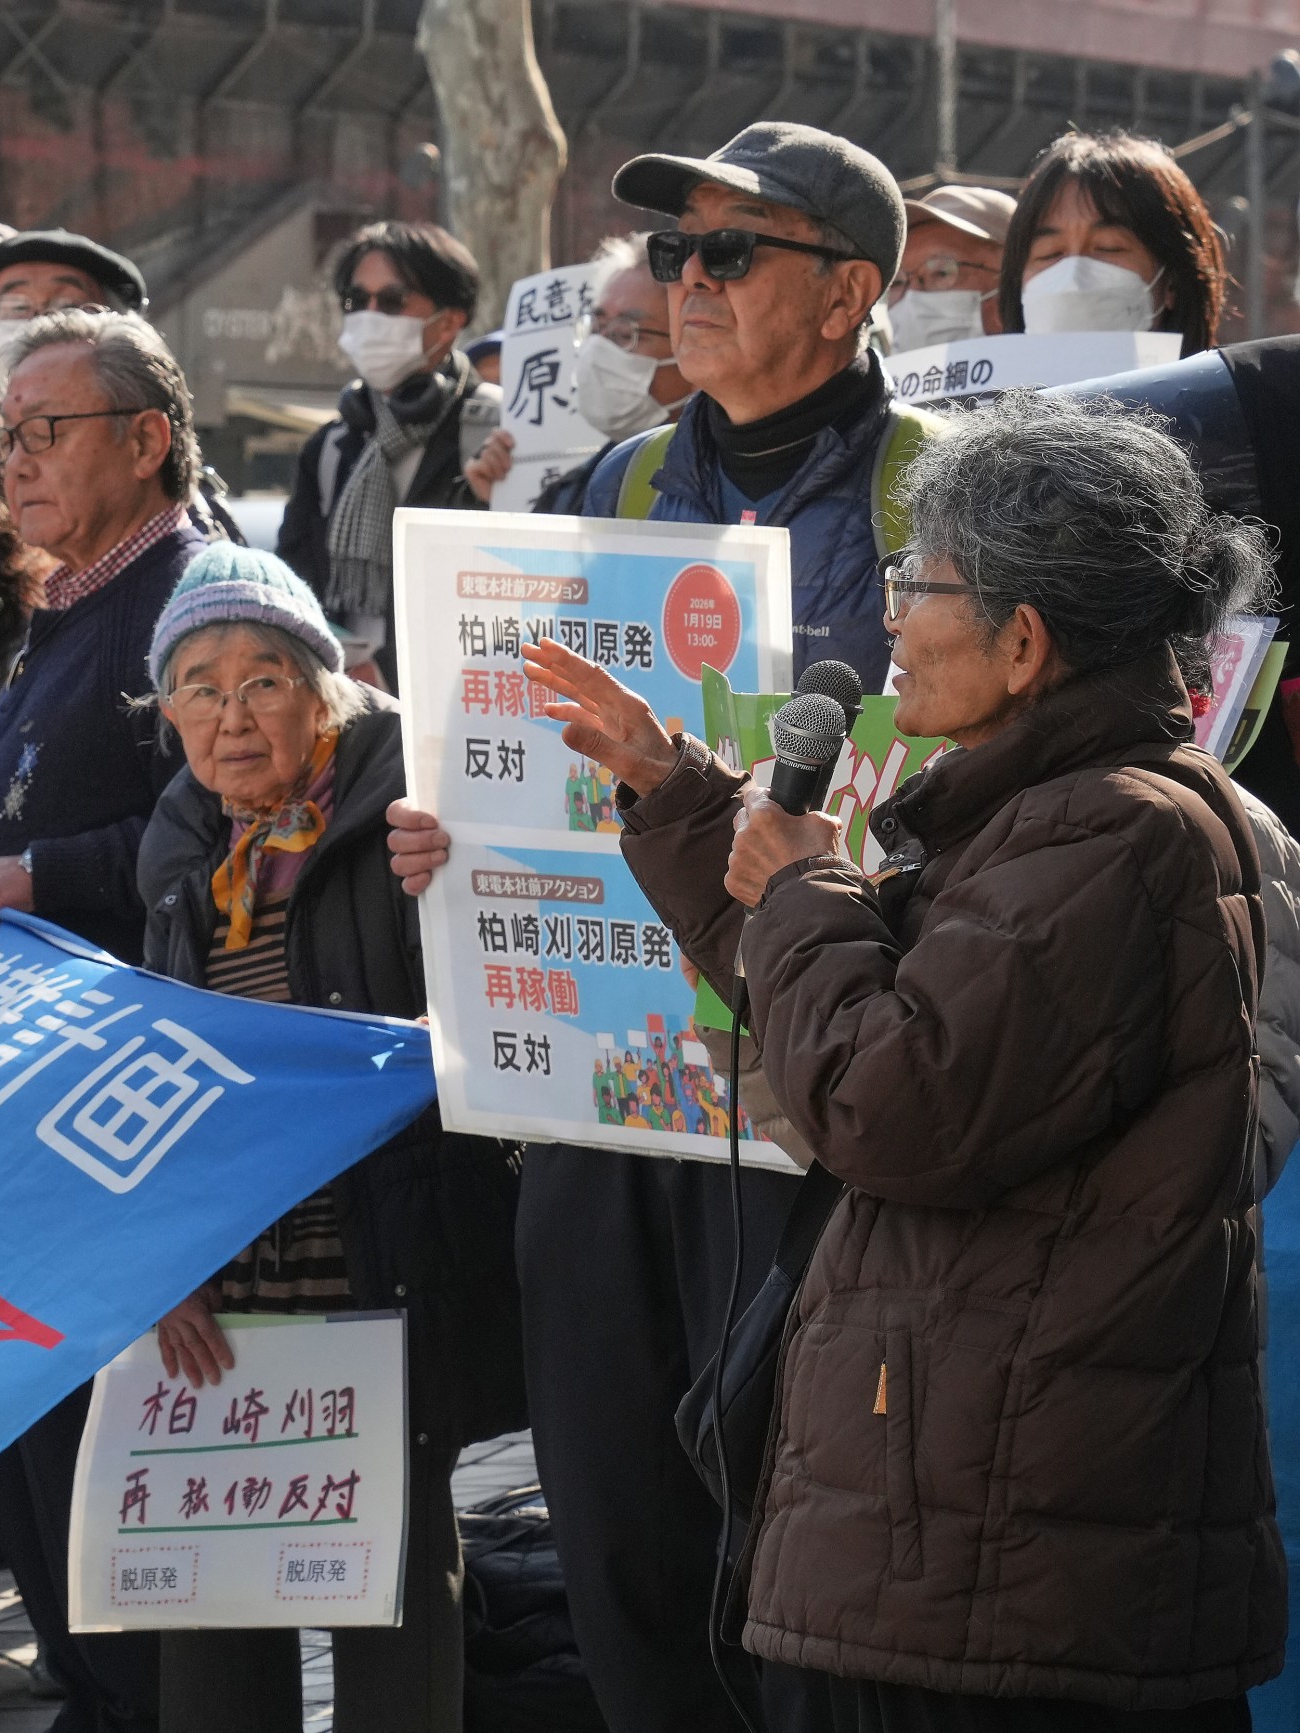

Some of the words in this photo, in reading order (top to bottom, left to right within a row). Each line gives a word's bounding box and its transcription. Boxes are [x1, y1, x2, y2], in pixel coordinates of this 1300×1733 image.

[508, 349, 577, 427] 原
[462, 576, 584, 601] 東電本社前アクション
[683, 612, 722, 629] 1月19日
[465, 736, 526, 783] 反対
[780, 757, 818, 772] MICROPHONE
[475, 873, 601, 900] 東電本社前アクション
[477, 911, 673, 969] 柏崎刈羽原発
[484, 963, 580, 1017] 再稼働
[492, 1030, 552, 1077] 反対
[138, 1381, 358, 1442] 柏崎刈羽
[120, 1567, 178, 1591] 脱原発
[285, 1559, 348, 1583] 脱原発
